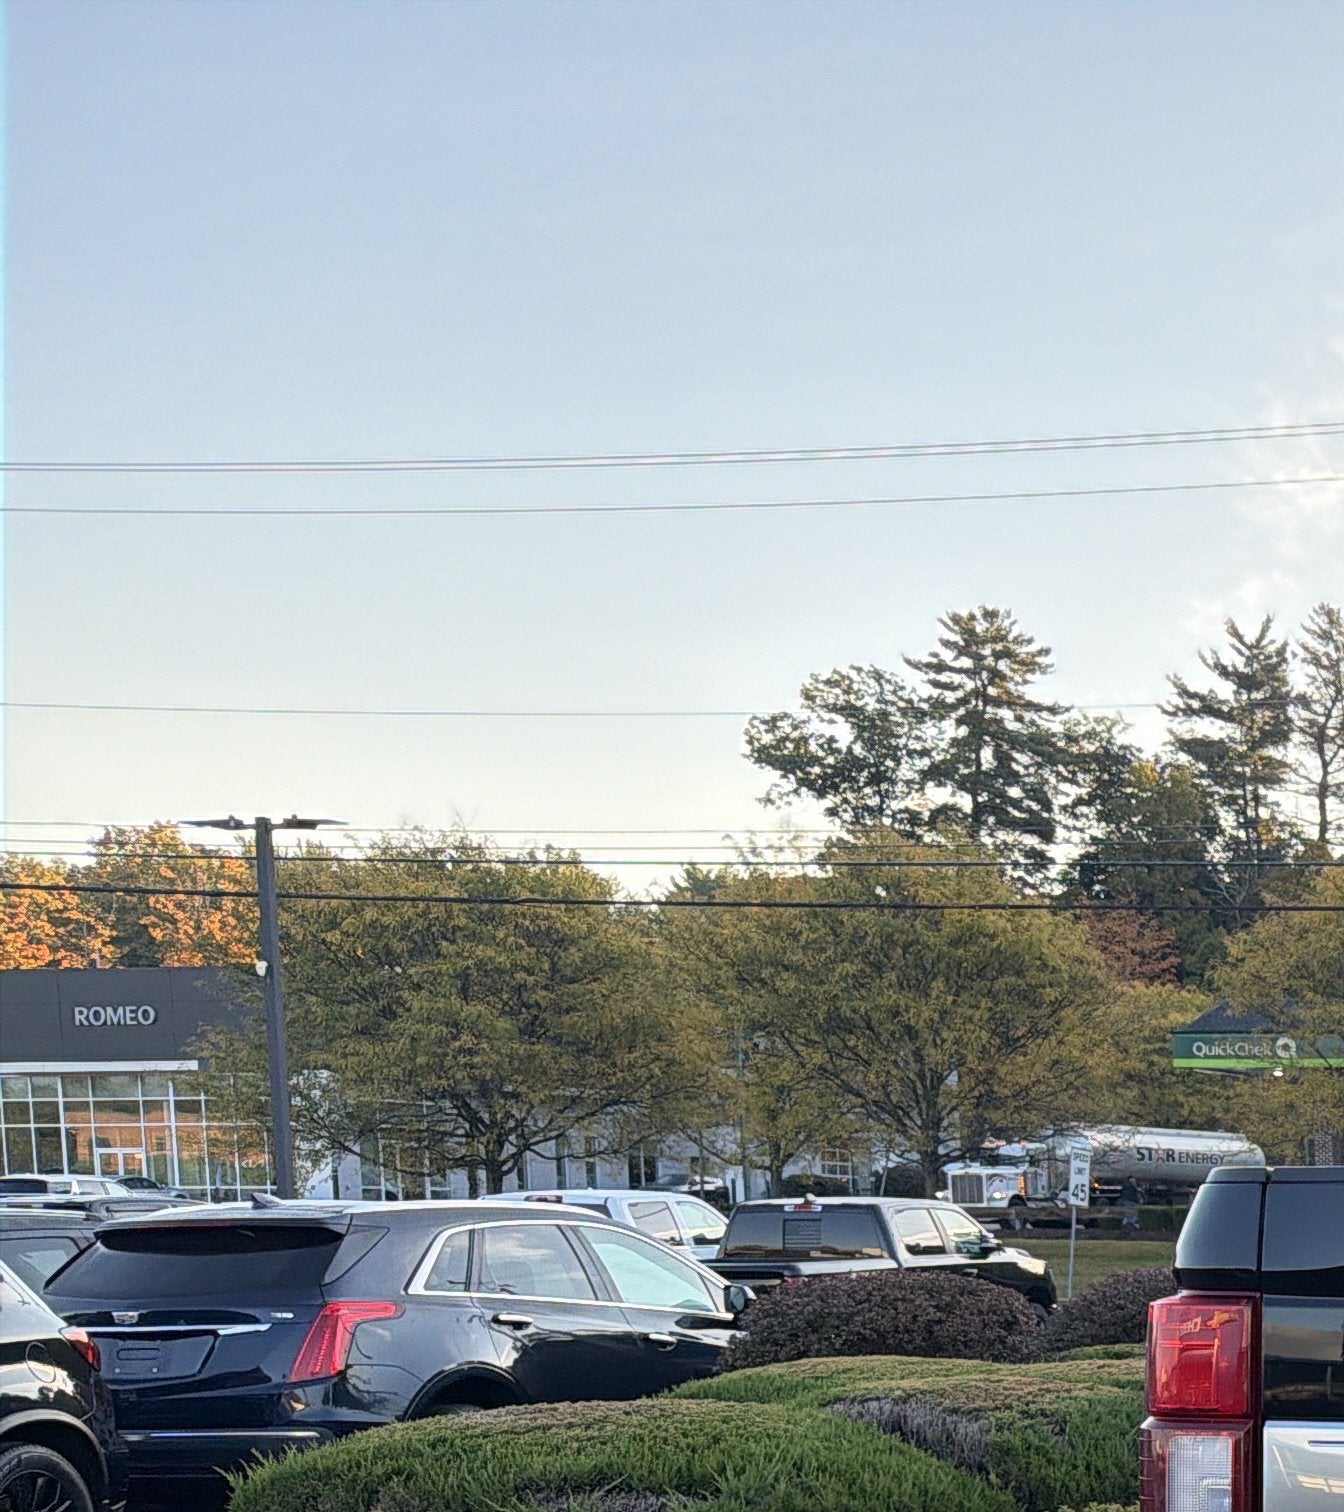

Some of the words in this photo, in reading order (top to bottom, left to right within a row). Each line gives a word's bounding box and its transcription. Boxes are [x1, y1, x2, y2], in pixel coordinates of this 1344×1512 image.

[74, 1005, 156, 1026] ROMEO
[1192, 1038, 1273, 1058] QuickChek
[1178, 1152, 1225, 1165] ENERGY
[1071, 1183, 1087, 1201] 45
